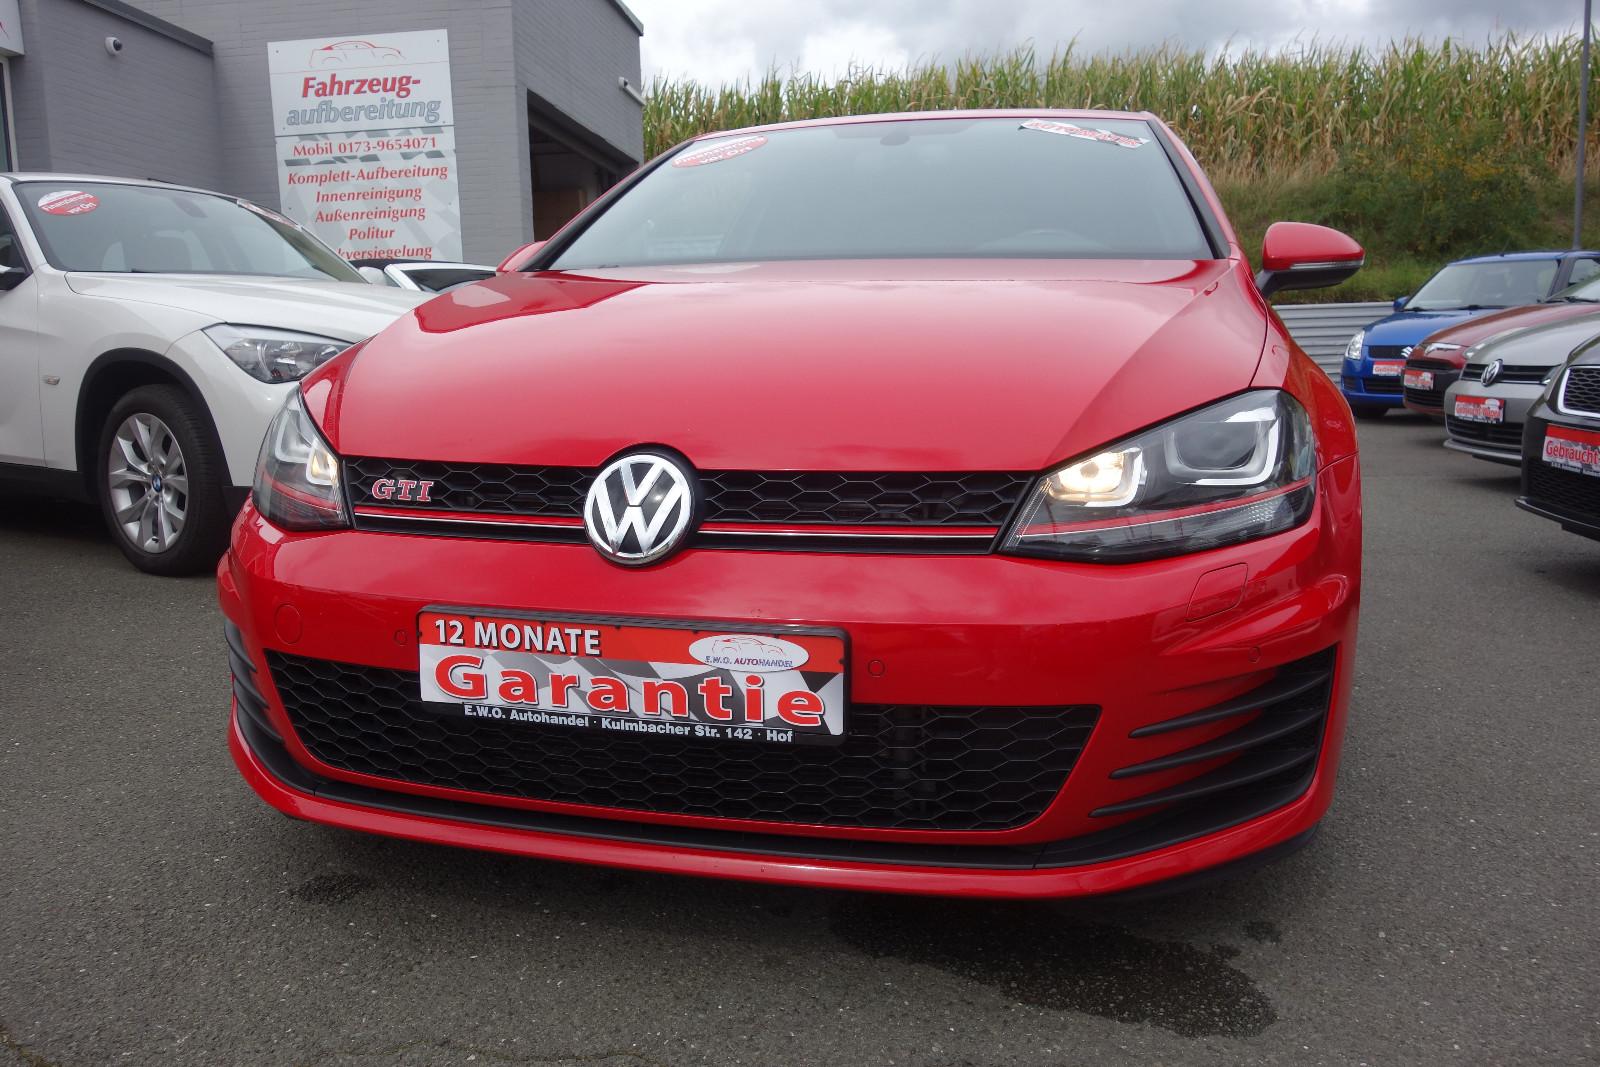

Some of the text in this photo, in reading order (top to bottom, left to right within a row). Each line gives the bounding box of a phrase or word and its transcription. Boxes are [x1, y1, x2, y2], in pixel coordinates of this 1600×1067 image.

[302, 73, 421, 98] Fahrzeug-
[286, 97, 441, 124] aufbereitung
[293, 136, 436, 157] Mobil 0173-9654071
[287, 165, 449, 187] Komplett-Aufbereitung
[316, 187, 422, 203] Innenreinigung
[315, 206, 426, 223] Außenreinigung
[348, 227, 395, 241] Politur
[371, 478, 433, 502] GTI
[589, 456, 690, 559] VW
[435, 619, 601, 656] 12 MONATE
[733, 657, 793, 667] AUTOHANDEL
[434, 654, 825, 727] Garantie
[464, 705, 793, 743] E.W.O. Autohandel Kulmbacher Str. 142 Hof
